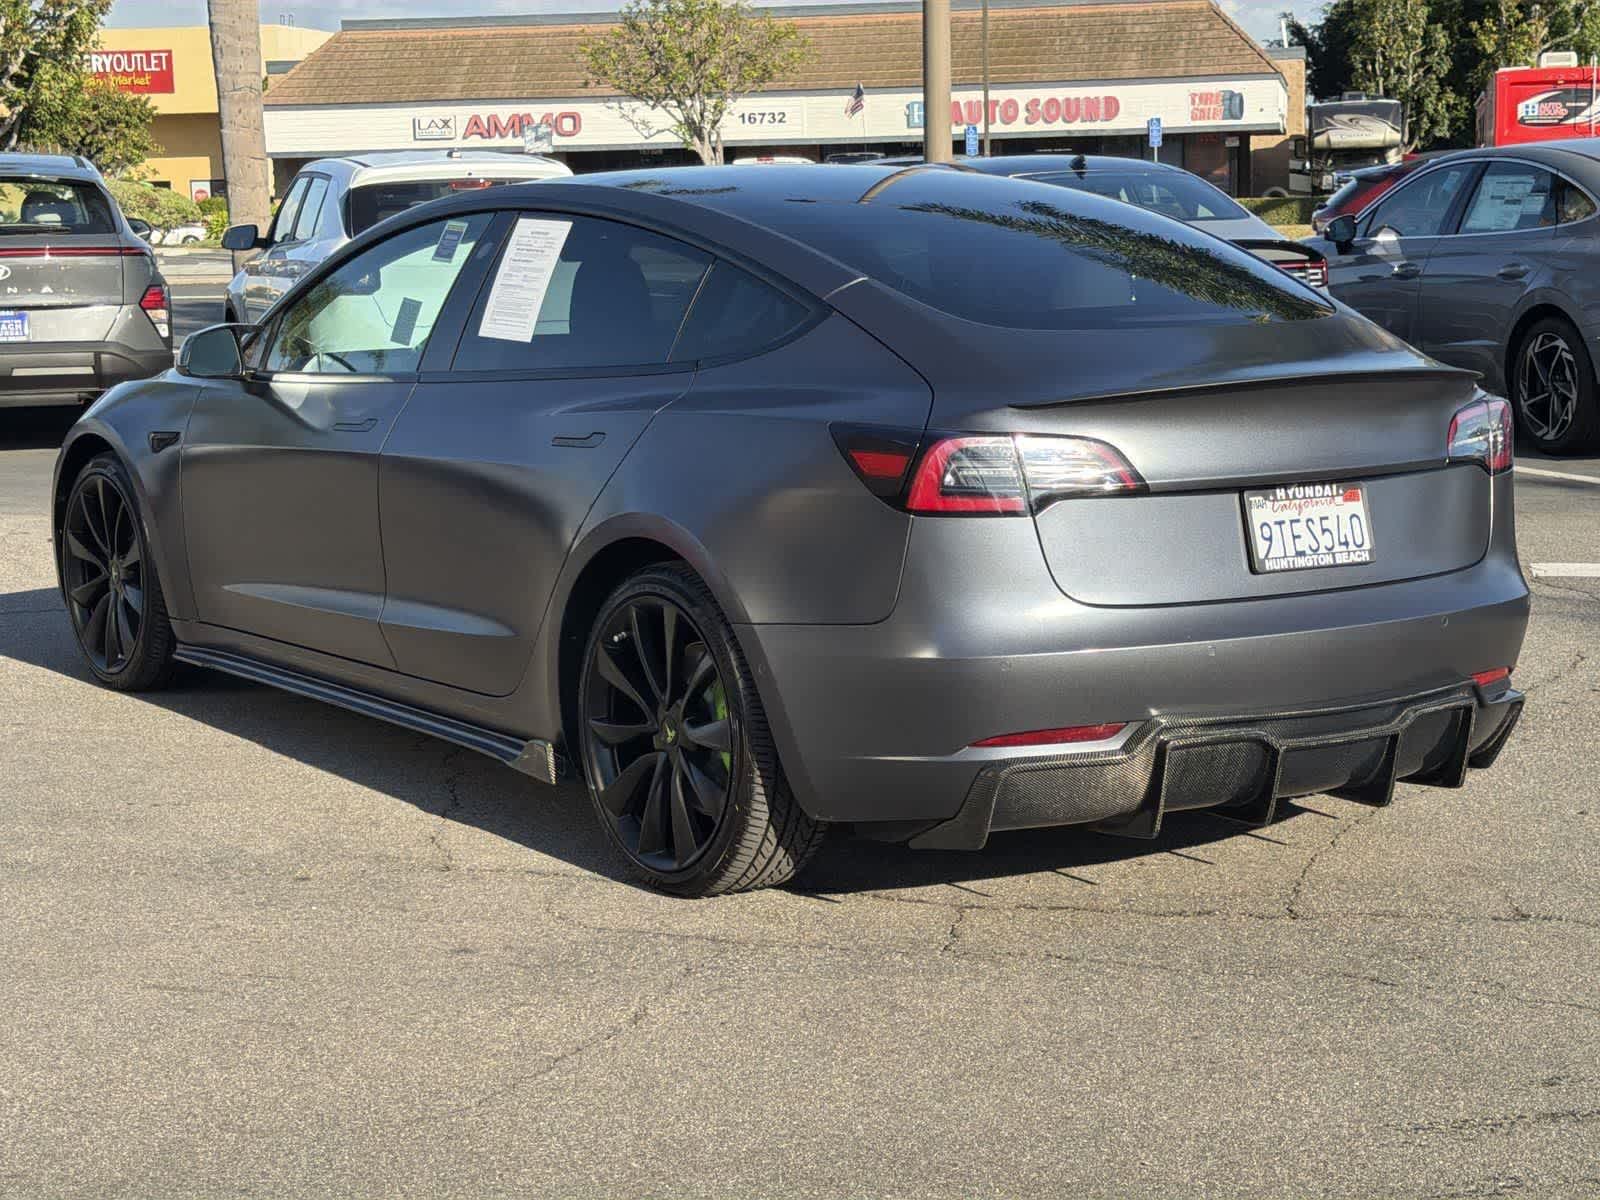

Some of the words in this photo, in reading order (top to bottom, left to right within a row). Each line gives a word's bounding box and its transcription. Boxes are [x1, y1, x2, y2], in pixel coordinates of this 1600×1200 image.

[738, 112, 786, 124] 16732
[951, 97, 1019, 126] AUTO
[1025, 96, 1120, 124] SOUND
[417, 118, 452, 131] LAX
[1276, 485, 1337, 500] HYUNDAI
[1260, 513, 1365, 559] 9TES540
[1265, 552, 1334, 571] HUNTINGTON
[1335, 550, 1370, 564] BEACH
